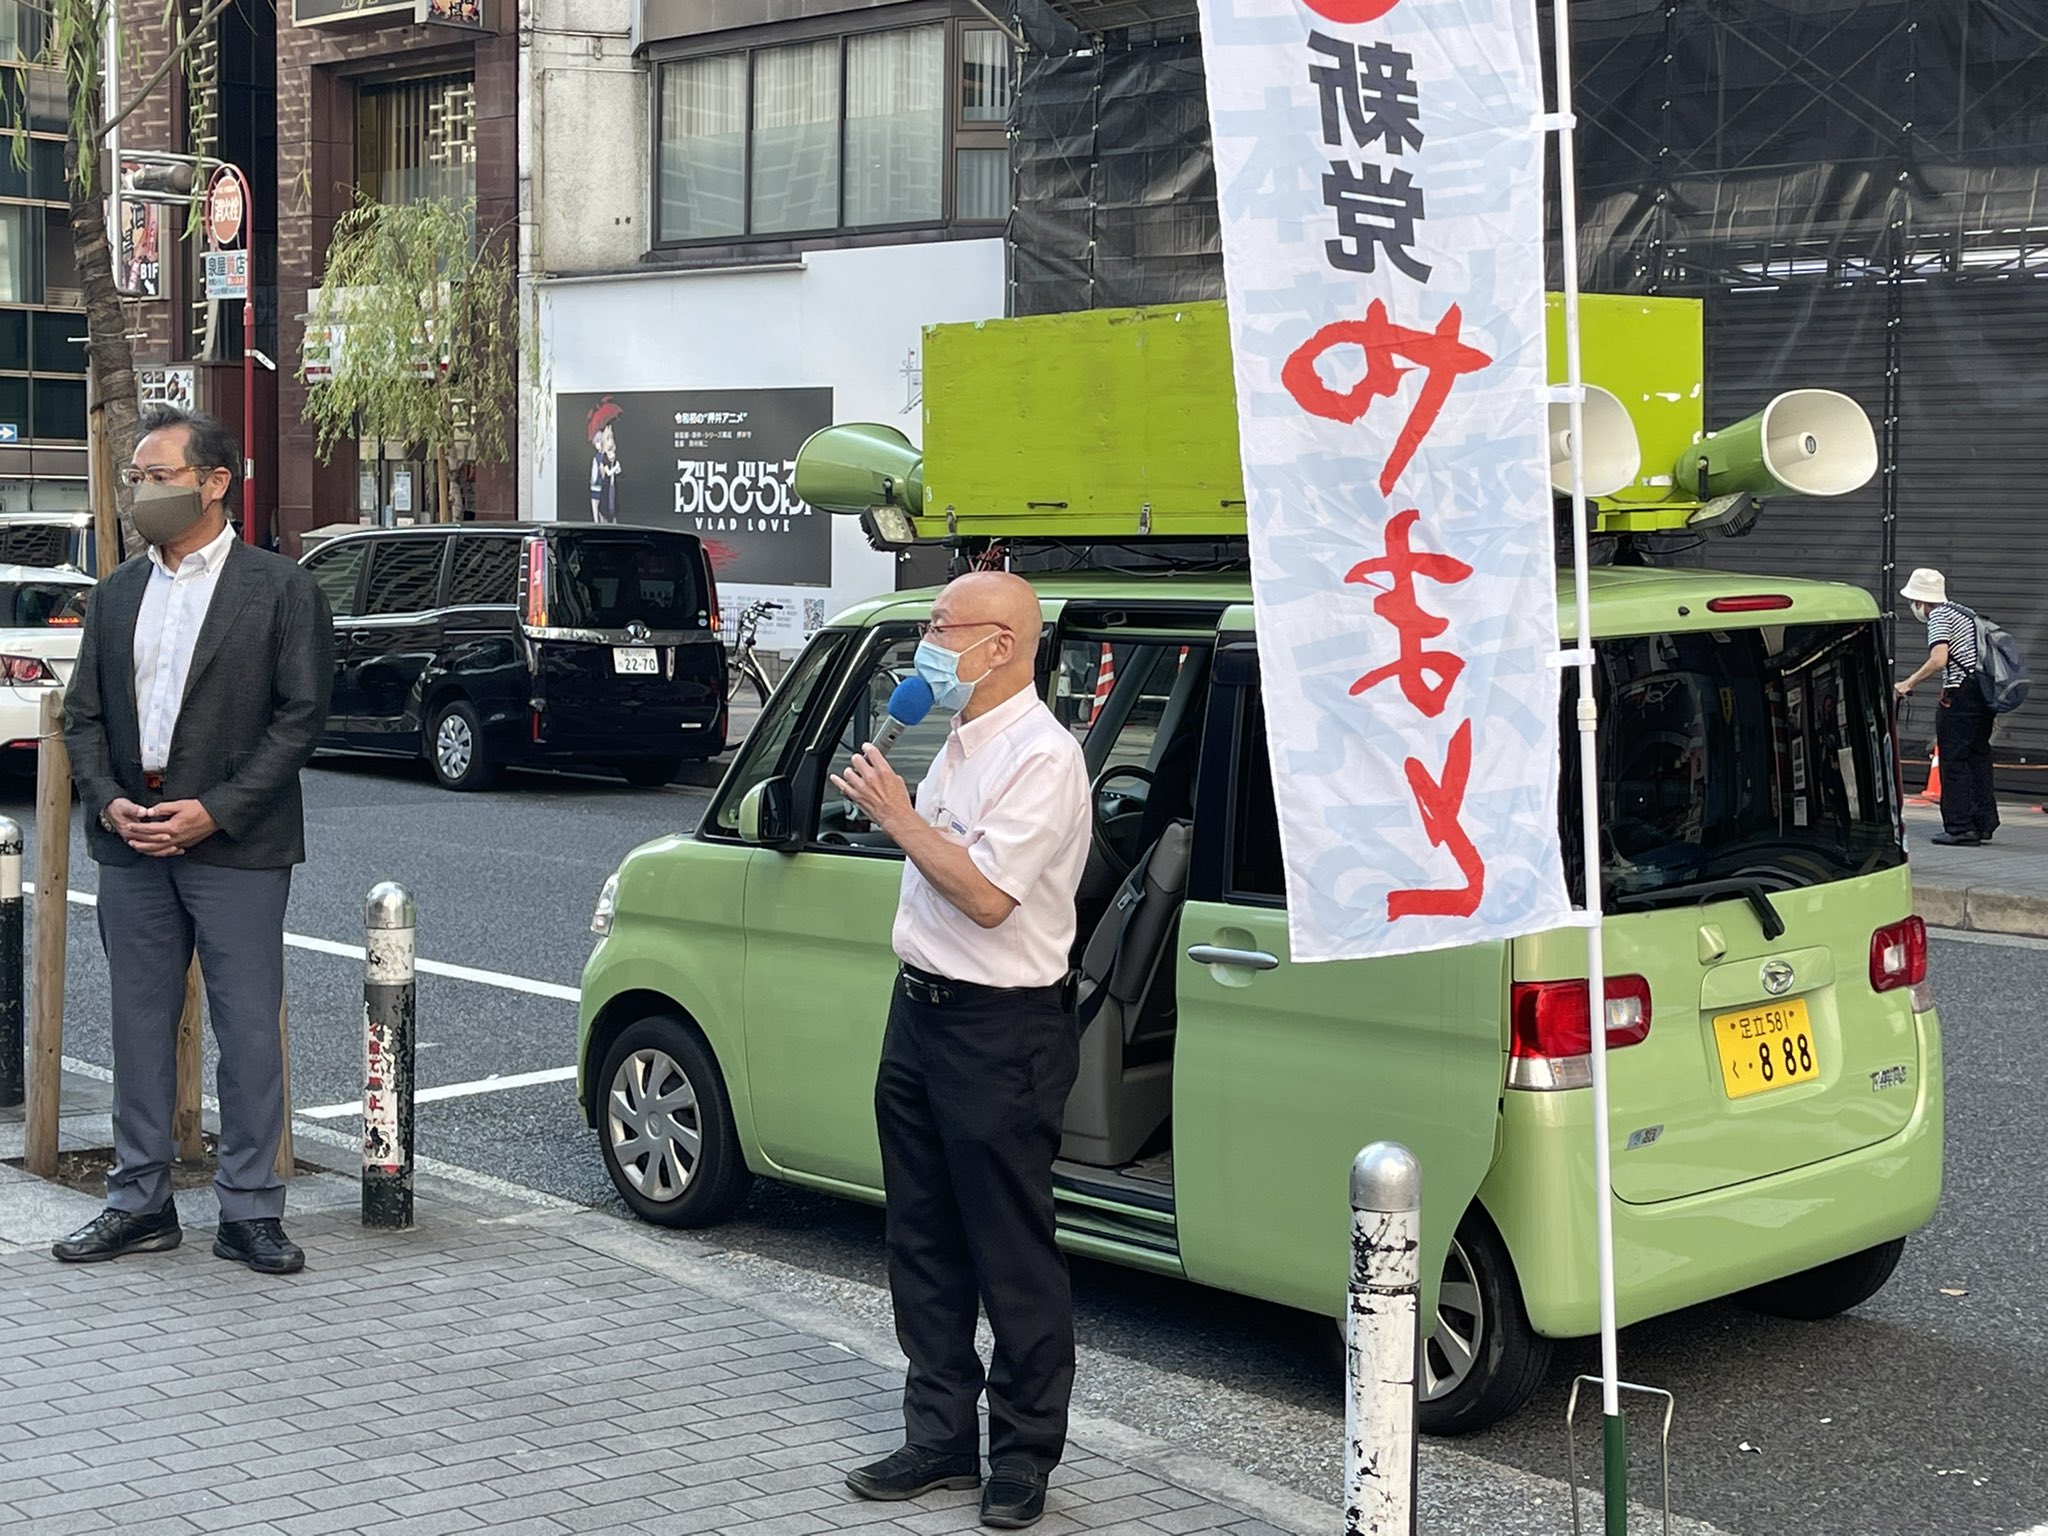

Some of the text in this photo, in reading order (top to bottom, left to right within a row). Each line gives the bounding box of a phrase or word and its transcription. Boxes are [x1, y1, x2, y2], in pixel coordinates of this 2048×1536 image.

[215, 196, 239, 222] 消火栓
[140, 262, 159, 281] B1F
[695, 517, 790, 532] VLAD LOVE
